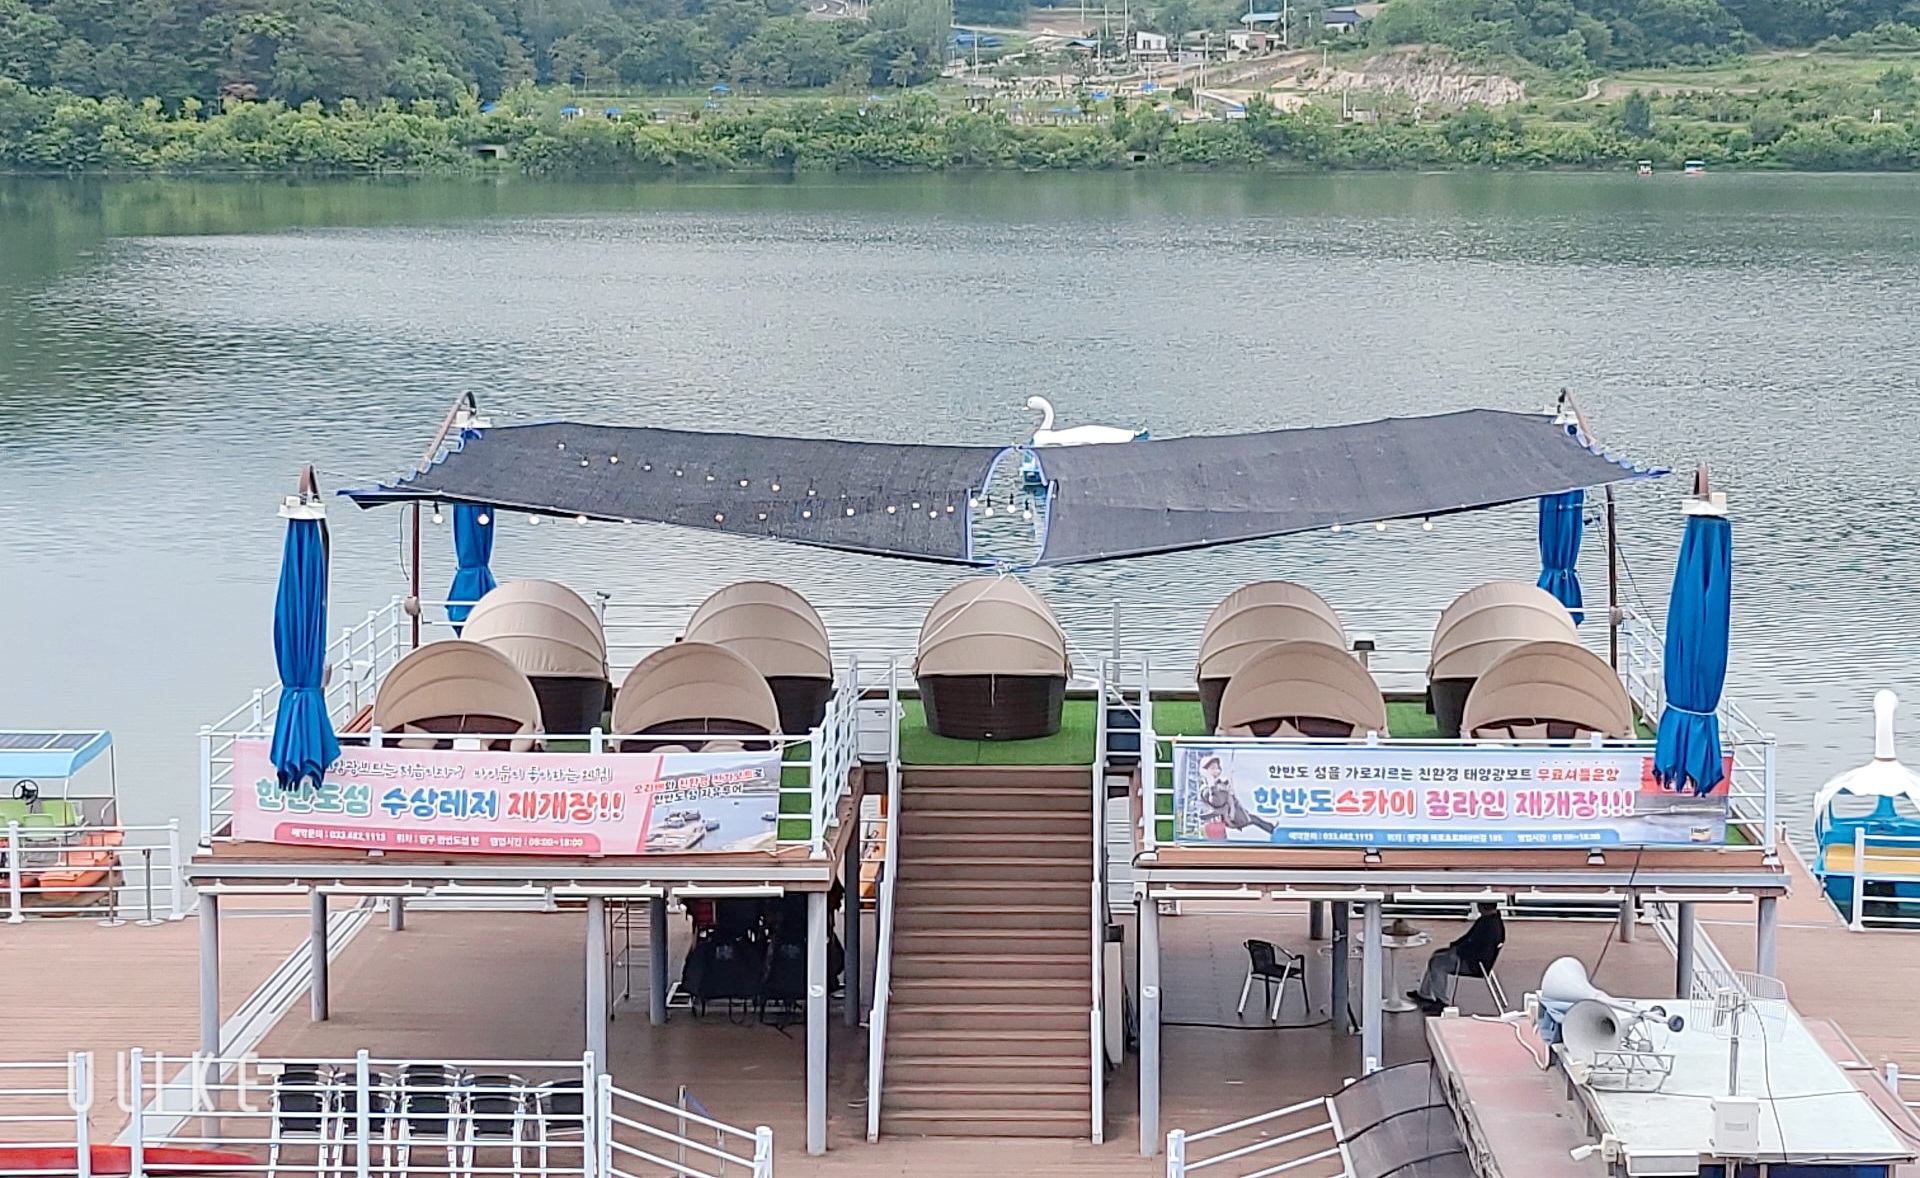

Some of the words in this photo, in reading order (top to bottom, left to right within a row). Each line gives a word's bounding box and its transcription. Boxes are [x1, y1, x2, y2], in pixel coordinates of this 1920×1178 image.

[328, 760, 397, 777] 양광보트는
[1268, 765, 1309, 779] 한반도
[1345, 766, 1413, 781] 가로지르는
[1418, 767, 1459, 782] 친환경
[1464, 768, 1533, 782] 태양광보트
[256, 779, 371, 815] 한반도섬
[381, 787, 497, 819] 수상레저
[507, 790, 624, 821] 재개장!!
[1254, 786, 1415, 816] 한반도스카이
[1515, 790, 1635, 817] 재개장!!!
